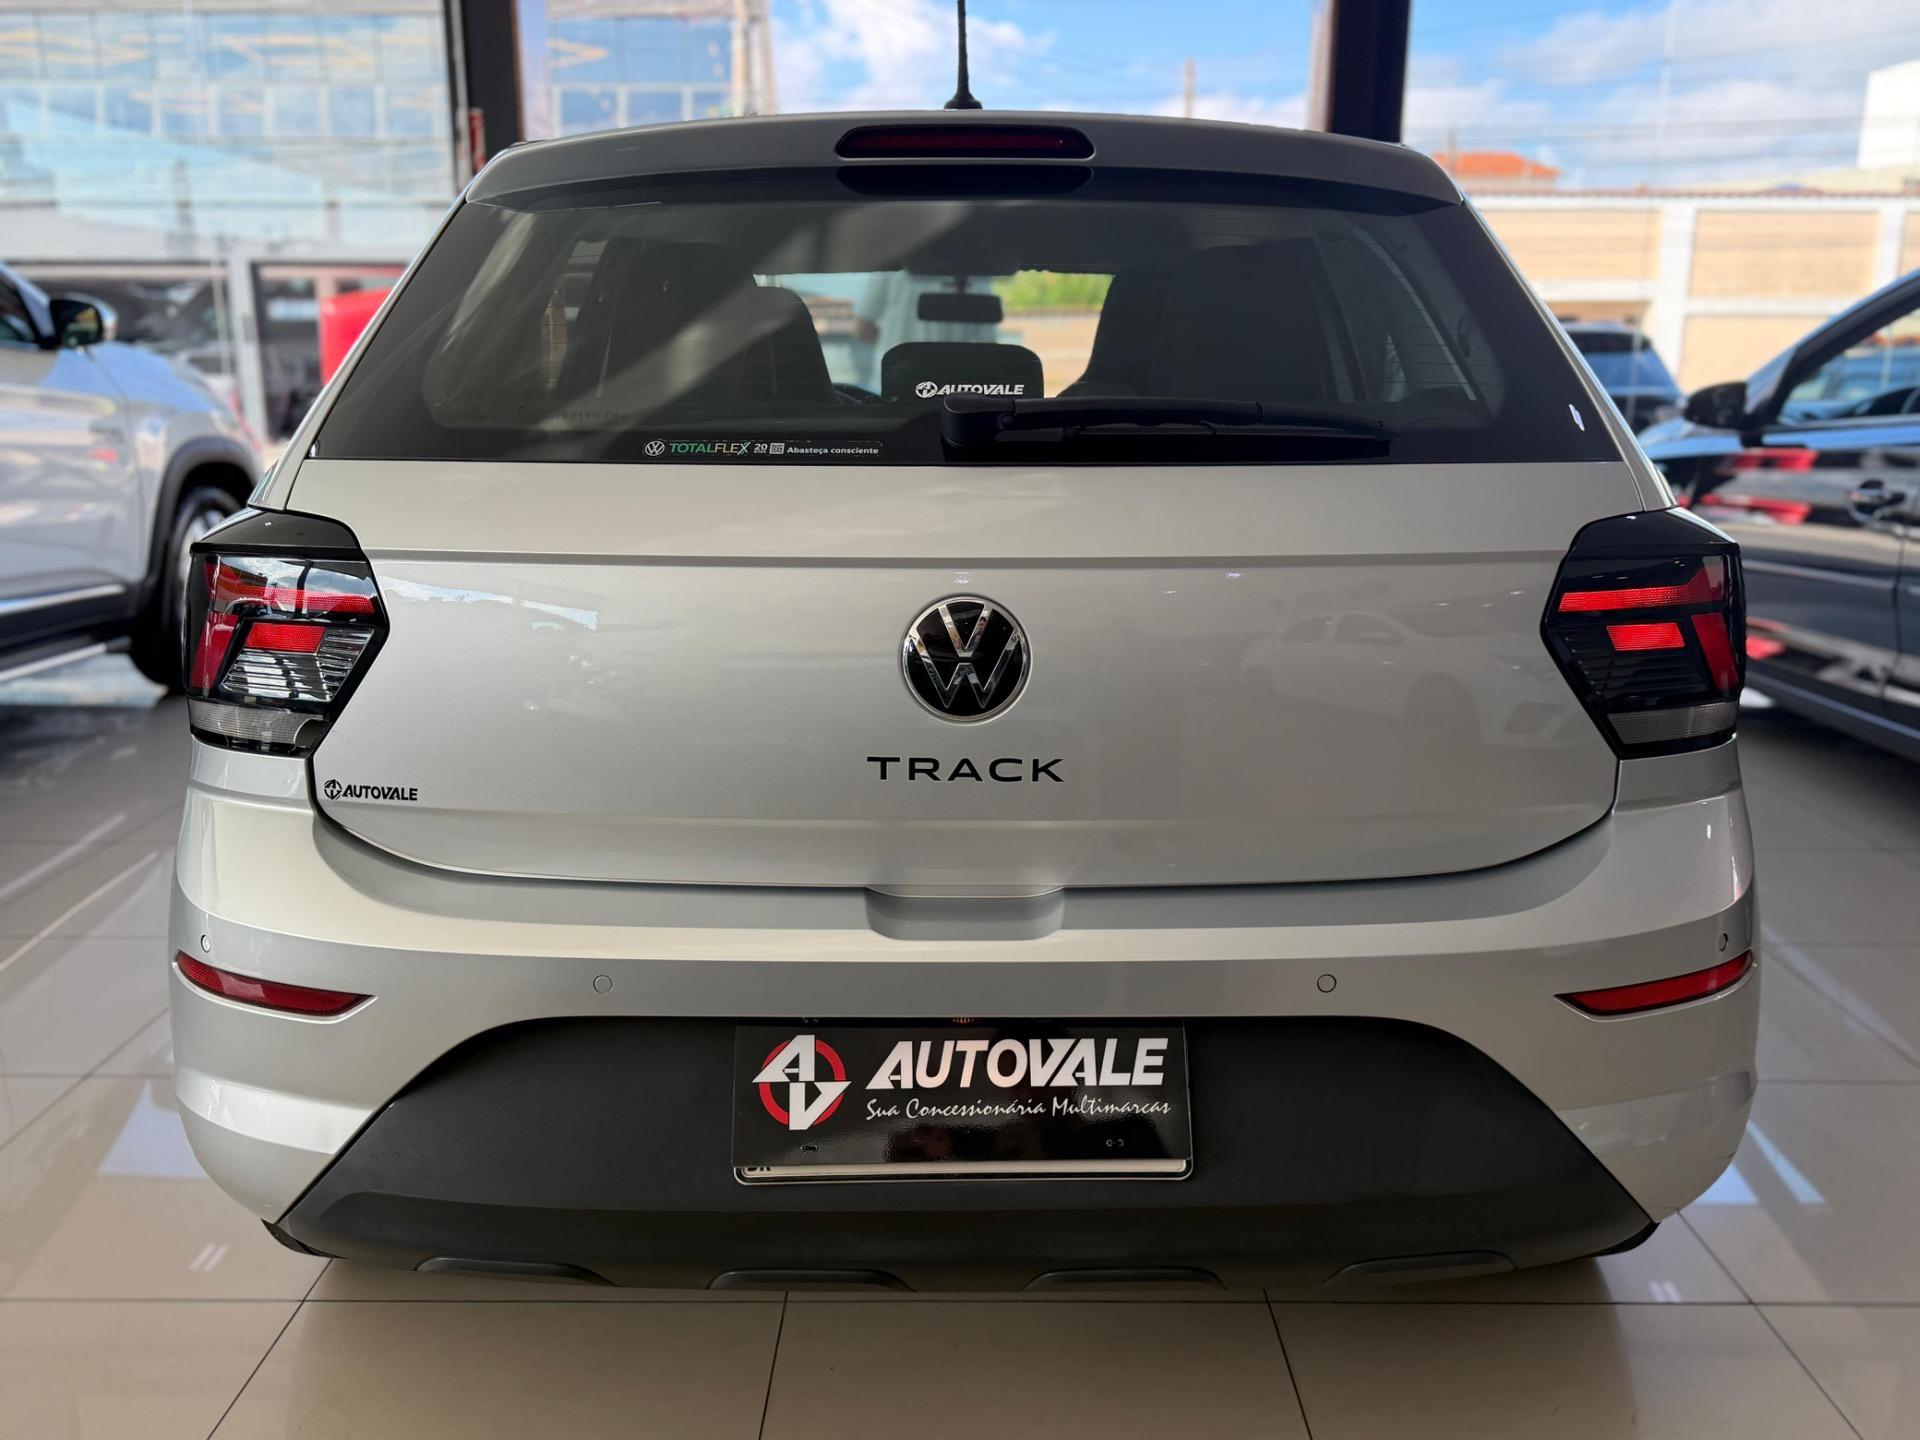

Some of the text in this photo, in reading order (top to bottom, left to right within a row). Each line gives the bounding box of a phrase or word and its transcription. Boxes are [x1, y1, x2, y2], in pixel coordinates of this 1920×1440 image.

[937, 384, 1024, 395] AUTOVALE
[670, 441, 751, 454] TOTALFLEX
[787, 447, 828, 455] Abasteça
[867, 756, 1065, 783] TRACK
[342, 784, 418, 801] AUTOVALE
[865, 1037, 1169, 1090] AUTOVALE
[866, 1094, 1172, 1121] Sua Concessionária Multimarcas
